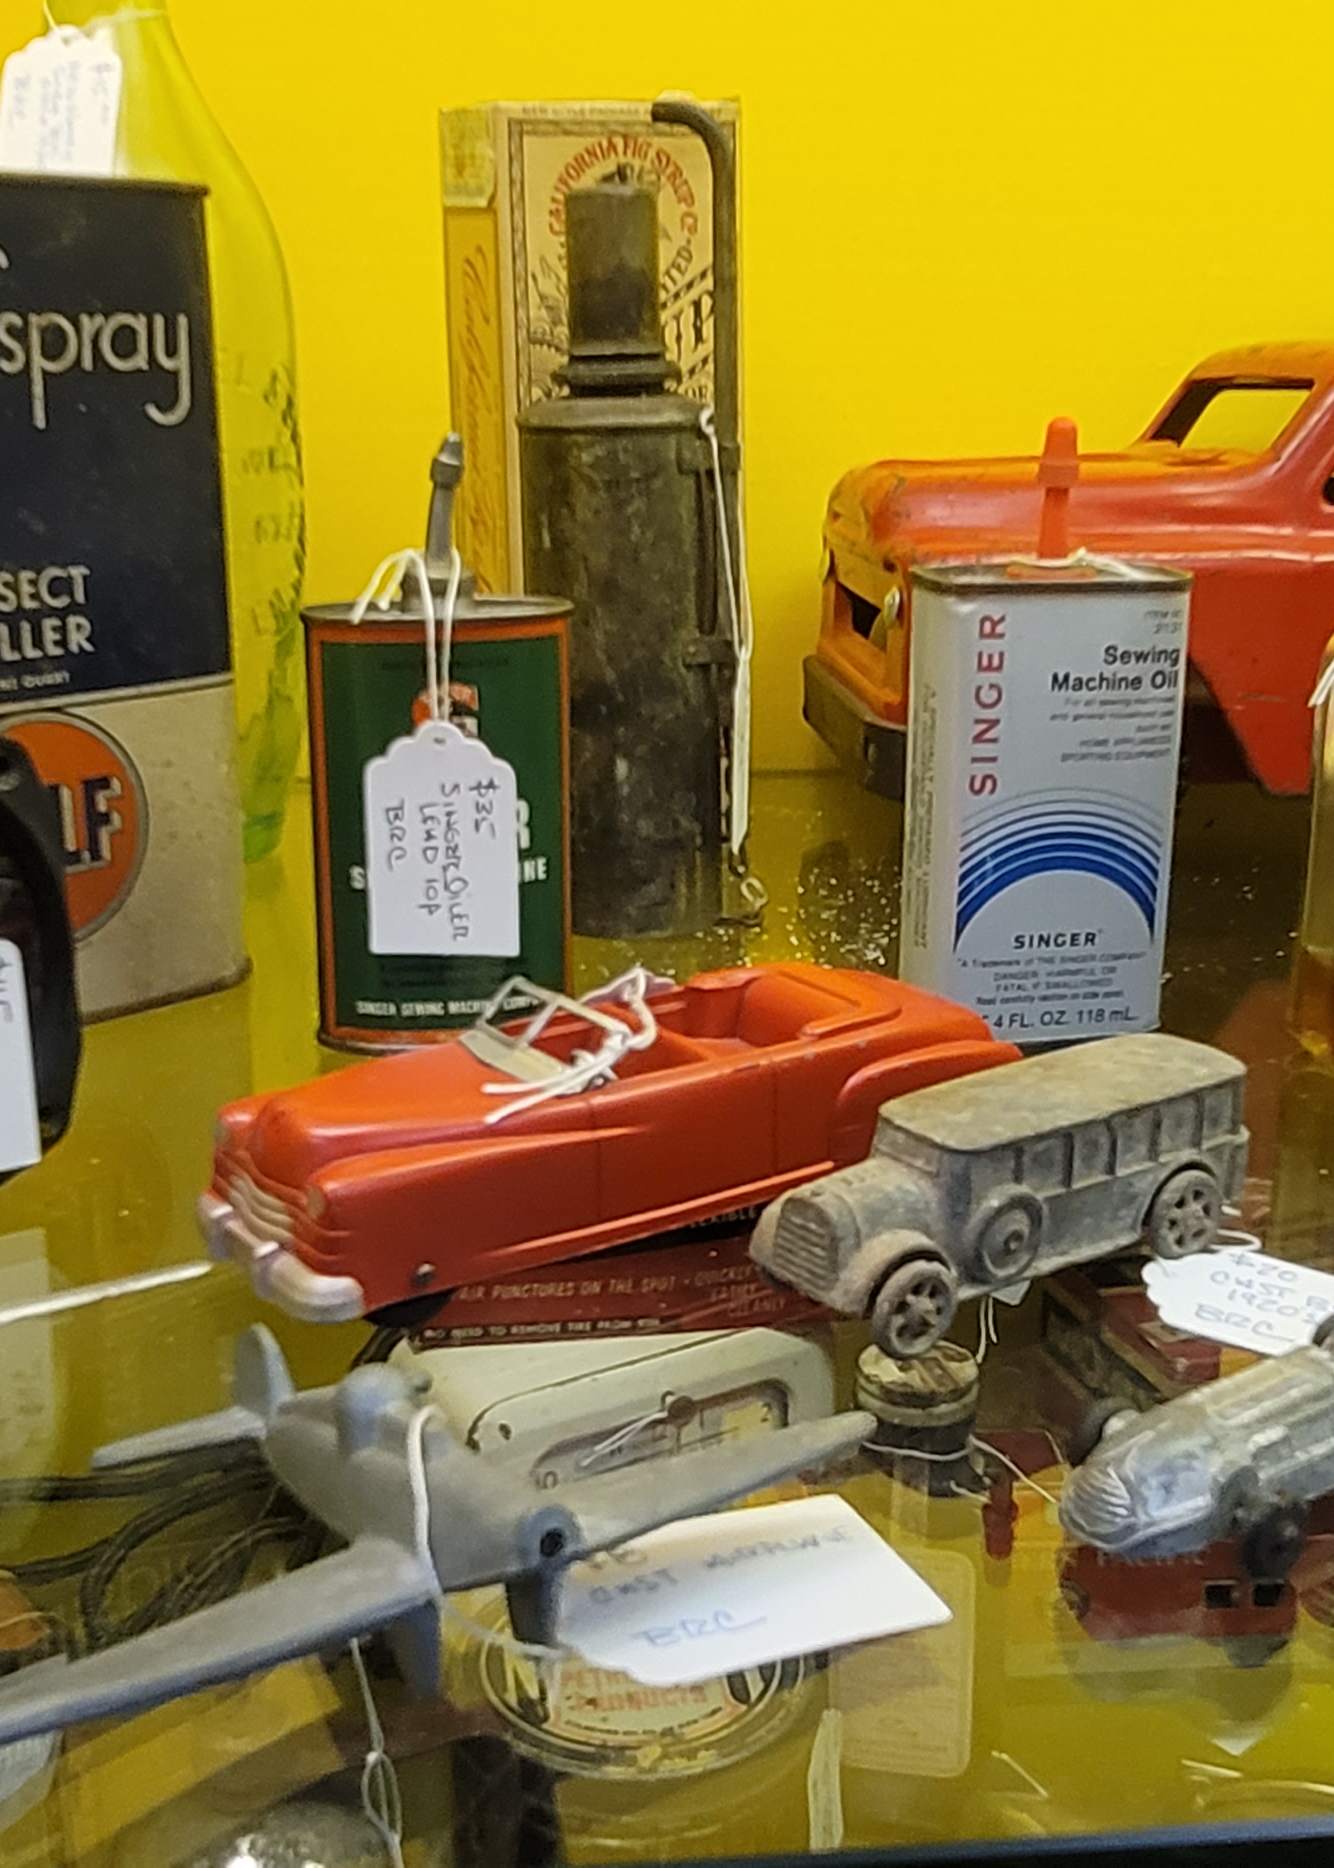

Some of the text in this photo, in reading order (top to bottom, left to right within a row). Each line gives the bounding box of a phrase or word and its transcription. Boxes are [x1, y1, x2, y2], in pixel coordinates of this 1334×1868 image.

[548, 135, 620, 238] CALIFORNIA
[621, 134, 653, 161] FIG
[653, 147, 696, 209] SYRUP
[1102, 643, 1182, 669] Sewing
[1049, 668, 1179, 693] Machine Oil
[969, 611, 1008, 797] SINGER
[52, 775, 124, 873] LF
[440, 781, 465, 872] SINGER
[468, 776, 501, 841] $35
[385, 796, 409, 872] BRC
[1012, 930, 1099, 950] SINGER
[355, 1000, 398, 1017] SINGER
[400, 1000, 446, 1017] SEWING
[993, 1014, 1005, 1029] 4
[1077, 1008, 1107, 1024] 118
[491, 1280, 576, 1299] PUNCTURES
[579, 1279, 603, 1297] ON
[607, 1277, 635, 1295] THE
[641, 1275, 677, 1294] SPOT
